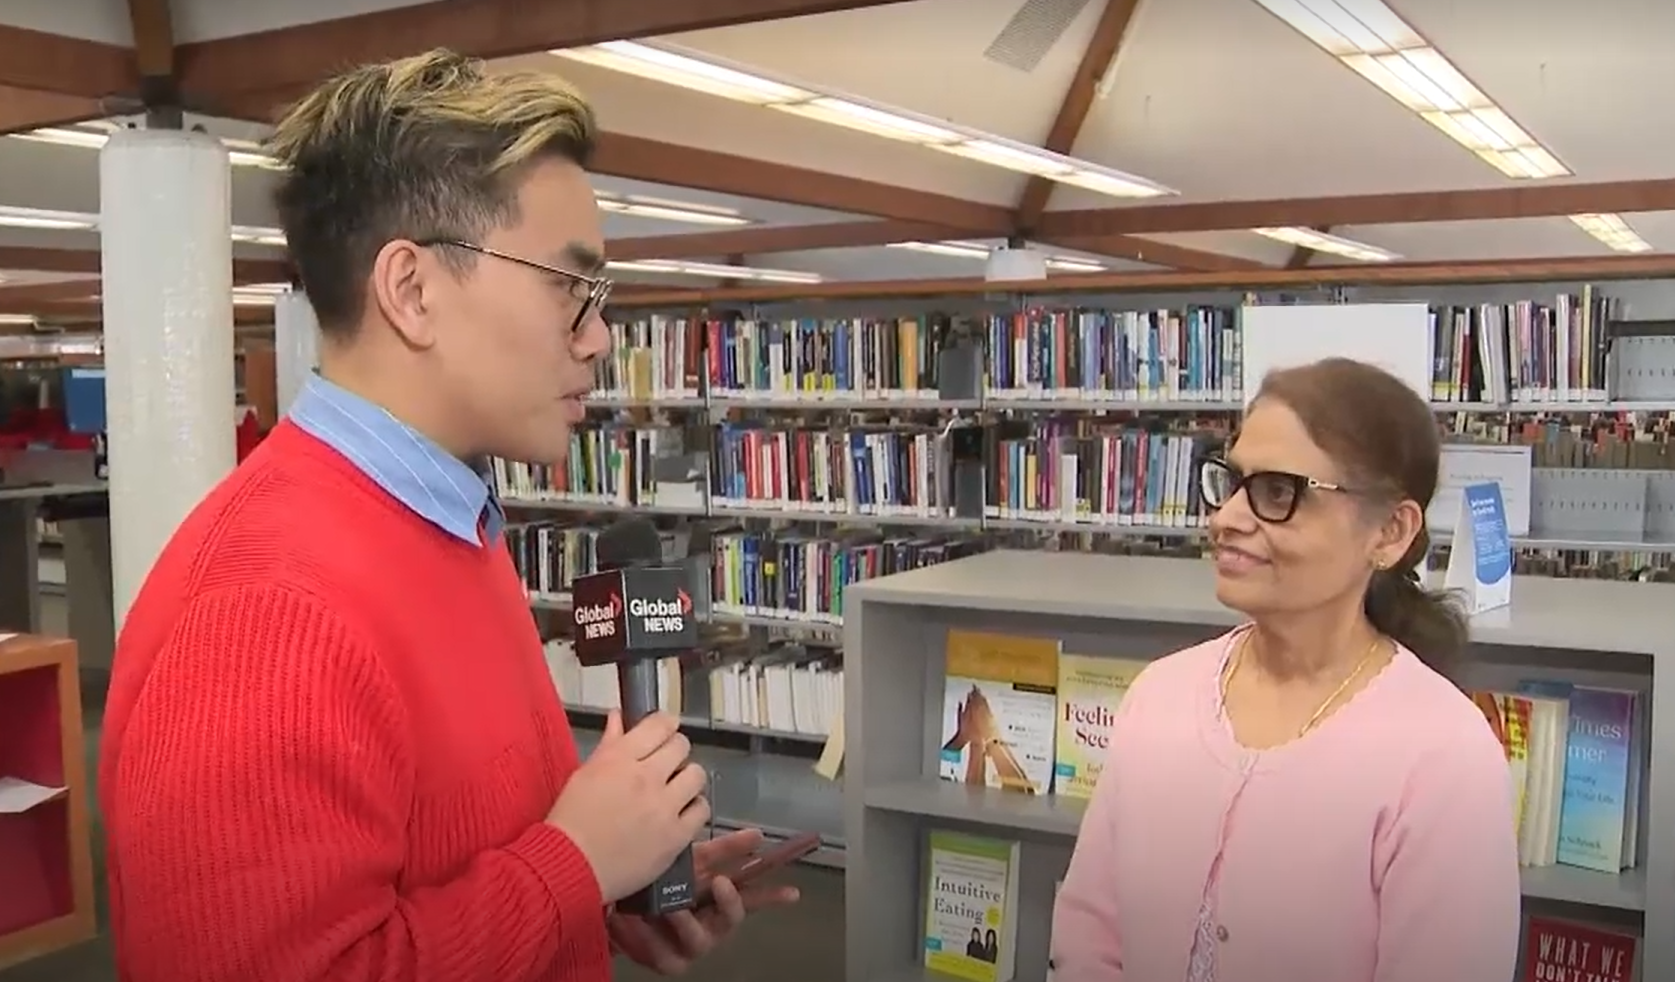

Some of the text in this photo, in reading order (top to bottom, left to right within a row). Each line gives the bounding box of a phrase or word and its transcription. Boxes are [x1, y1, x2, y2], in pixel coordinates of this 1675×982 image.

[575, 601, 614, 625] Global
[630, 598, 681, 616] Global
[585, 620, 616, 639] NEWS
[644, 617, 683, 632] NEWS
[1074, 728, 1109, 749] See
[1568, 744, 1607, 763] mer
[934, 876, 1001, 903] Intuitive
[934, 897, 984, 924] Eating
[1540, 932, 1624, 978] WHAT WE
